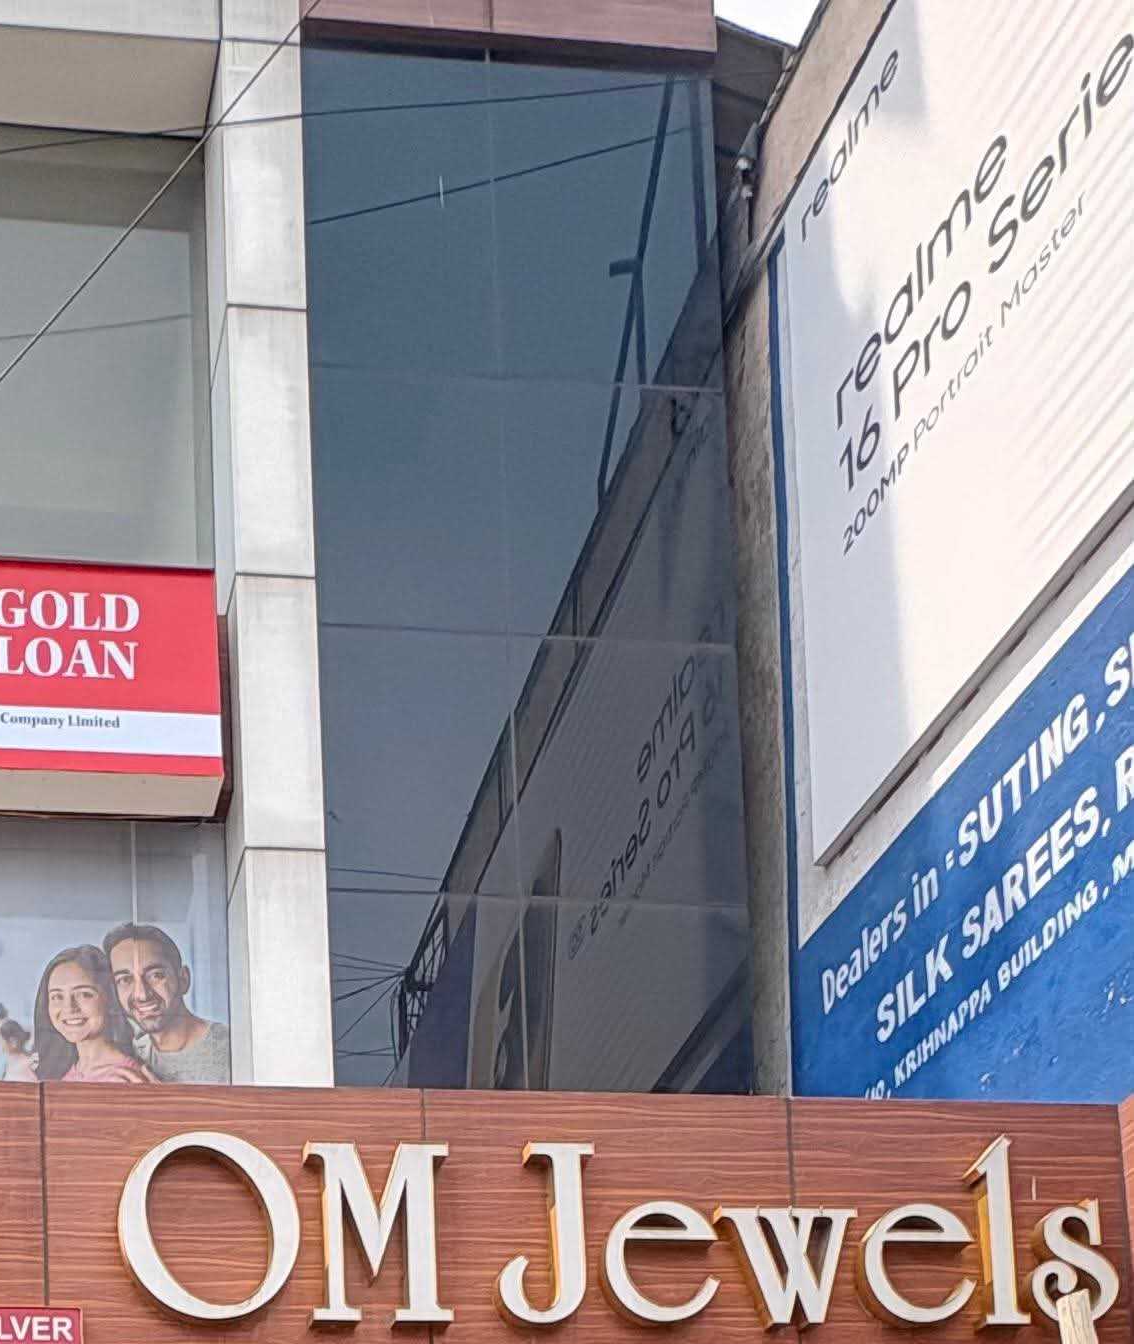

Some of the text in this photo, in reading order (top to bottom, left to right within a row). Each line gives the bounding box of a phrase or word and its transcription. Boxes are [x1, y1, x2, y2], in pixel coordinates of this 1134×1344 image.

[800, 49, 899, 242] realme
[835, 135, 1007, 430] realme
[837, 404, 880, 493] 16
[892, 280, 971, 422] Pro
[842, 190, 1086, 556] 200MP Portrait Master
[0, 711, 65, 730] Company
[68, 715, 121, 729] Limited
[821, 900, 907, 1015] Dealers
[912, 870, 939, 922] in
[1104, 630, 1134, 707] S
[876, 935, 954, 1044] SILK
[961, 785, 1111, 960] SAREES,
[894, 979, 991, 1089] KRIHNAPPA
[118, 1130, 1121, 1328] OM Jewels
